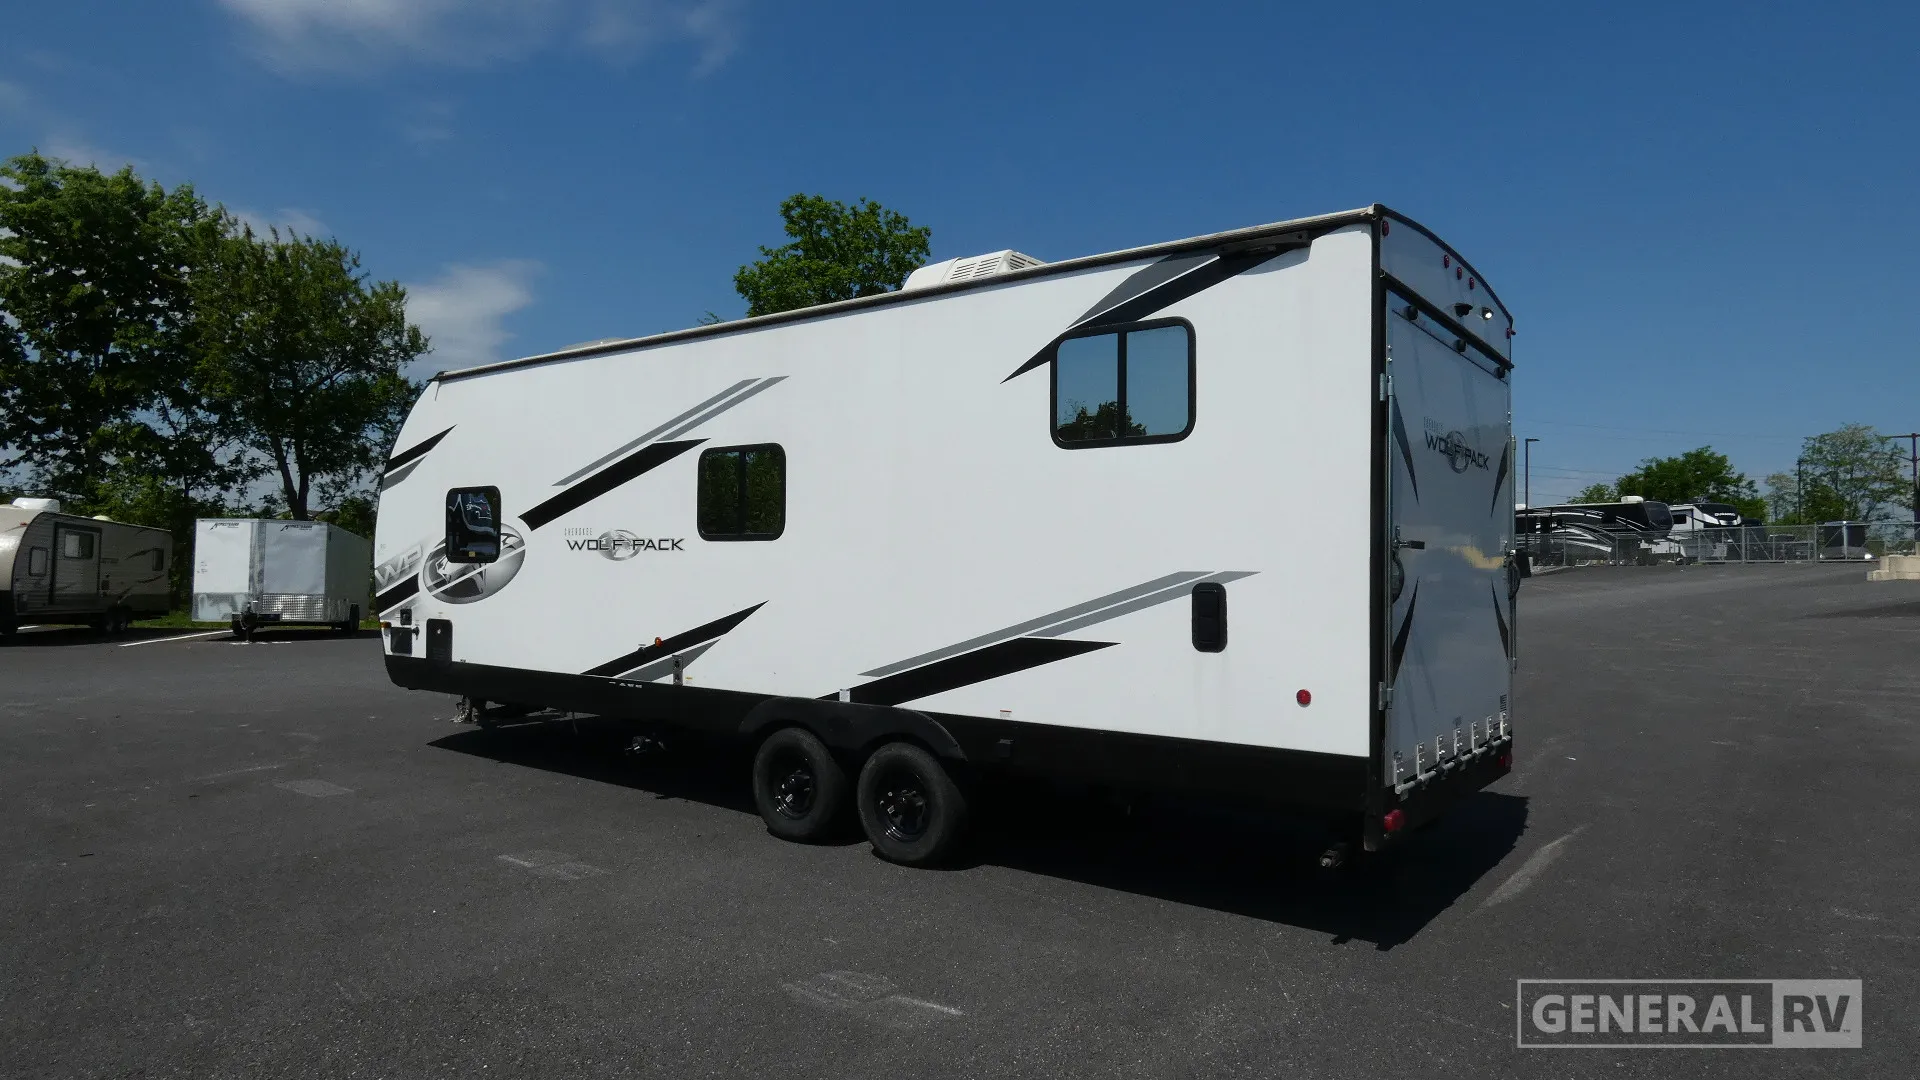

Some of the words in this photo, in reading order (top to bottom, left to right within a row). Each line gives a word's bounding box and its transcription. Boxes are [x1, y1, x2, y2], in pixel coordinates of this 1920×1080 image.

[1425, 430, 1463, 460] WOLF
[1465, 446, 1490, 471] PACK
[566, 539, 624, 551] WOLF
[632, 538, 685, 551] PACK
